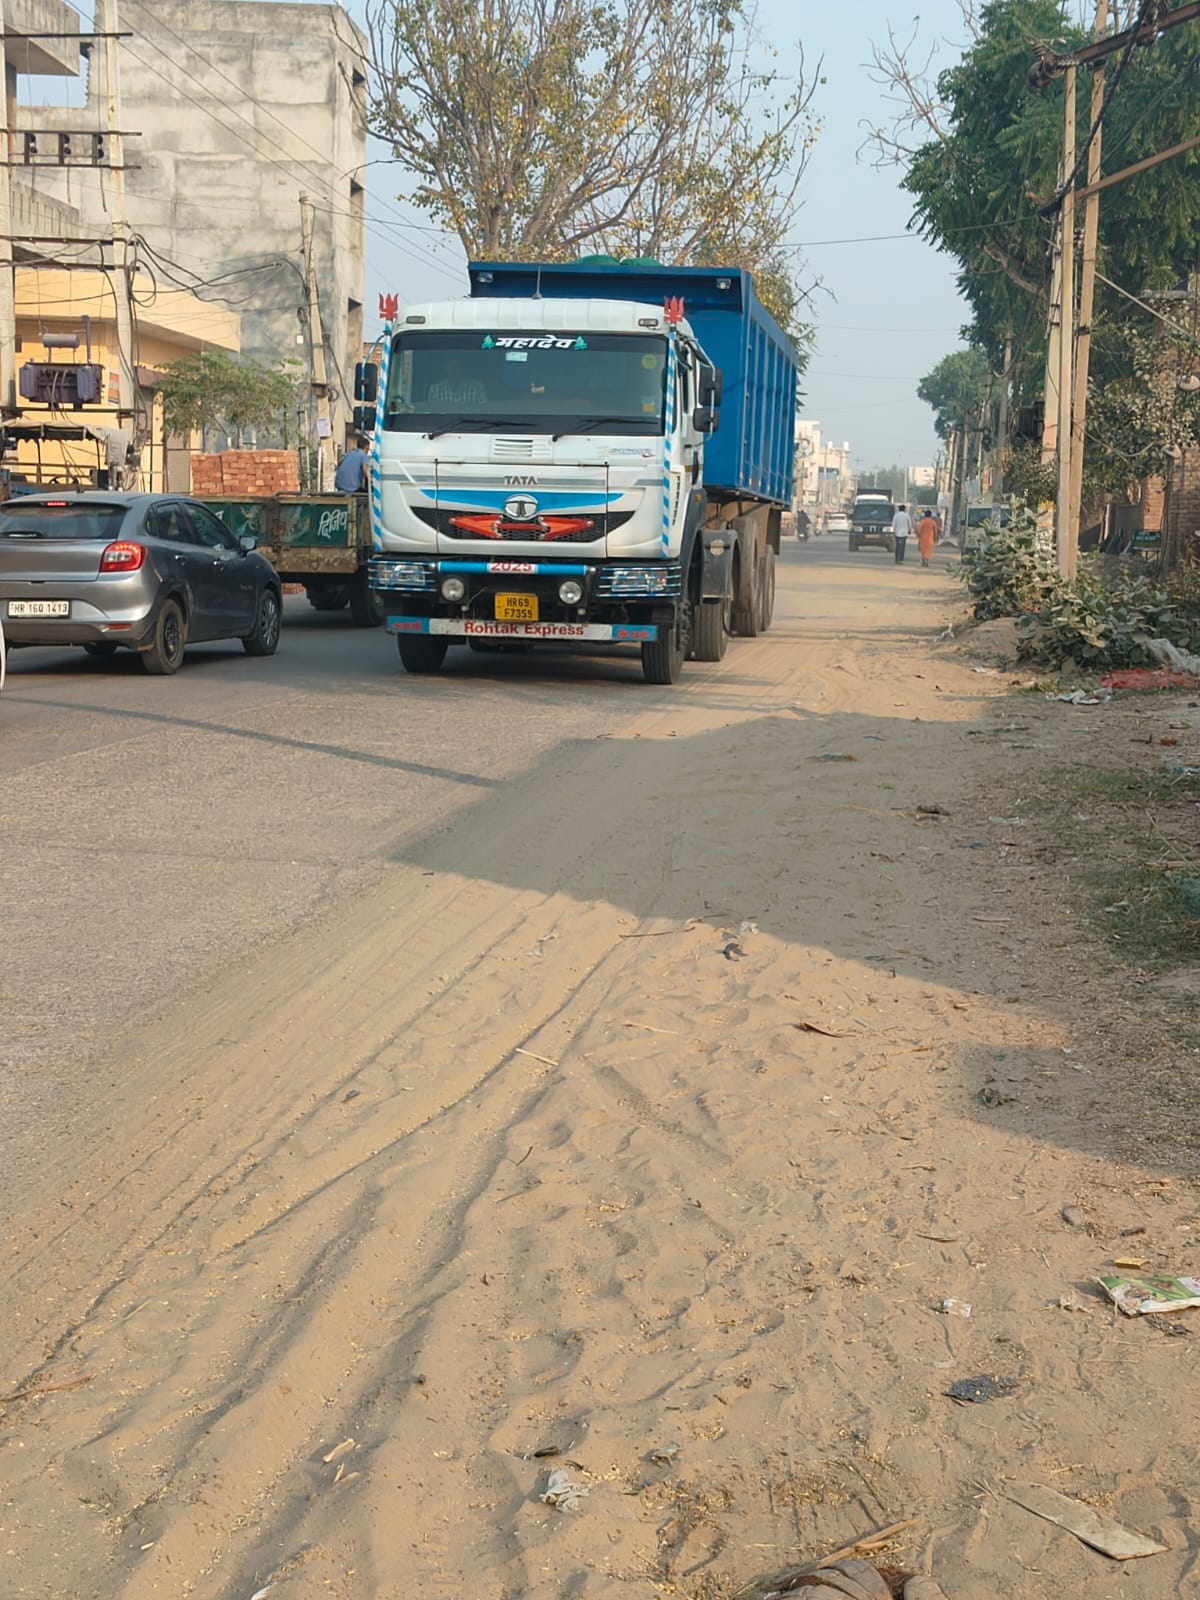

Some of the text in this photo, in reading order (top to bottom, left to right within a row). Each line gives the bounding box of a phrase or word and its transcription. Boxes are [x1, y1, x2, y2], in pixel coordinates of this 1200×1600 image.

[495, 334, 576, 349] महादेव
[503, 475, 537, 485] TATA
[14, 603, 25, 613] HR
[47, 603, 68, 613] 1413
[506, 597, 530, 608] HR69
[504, 608, 533, 619] F7359
[464, 621, 584, 638] Rohtak Express
